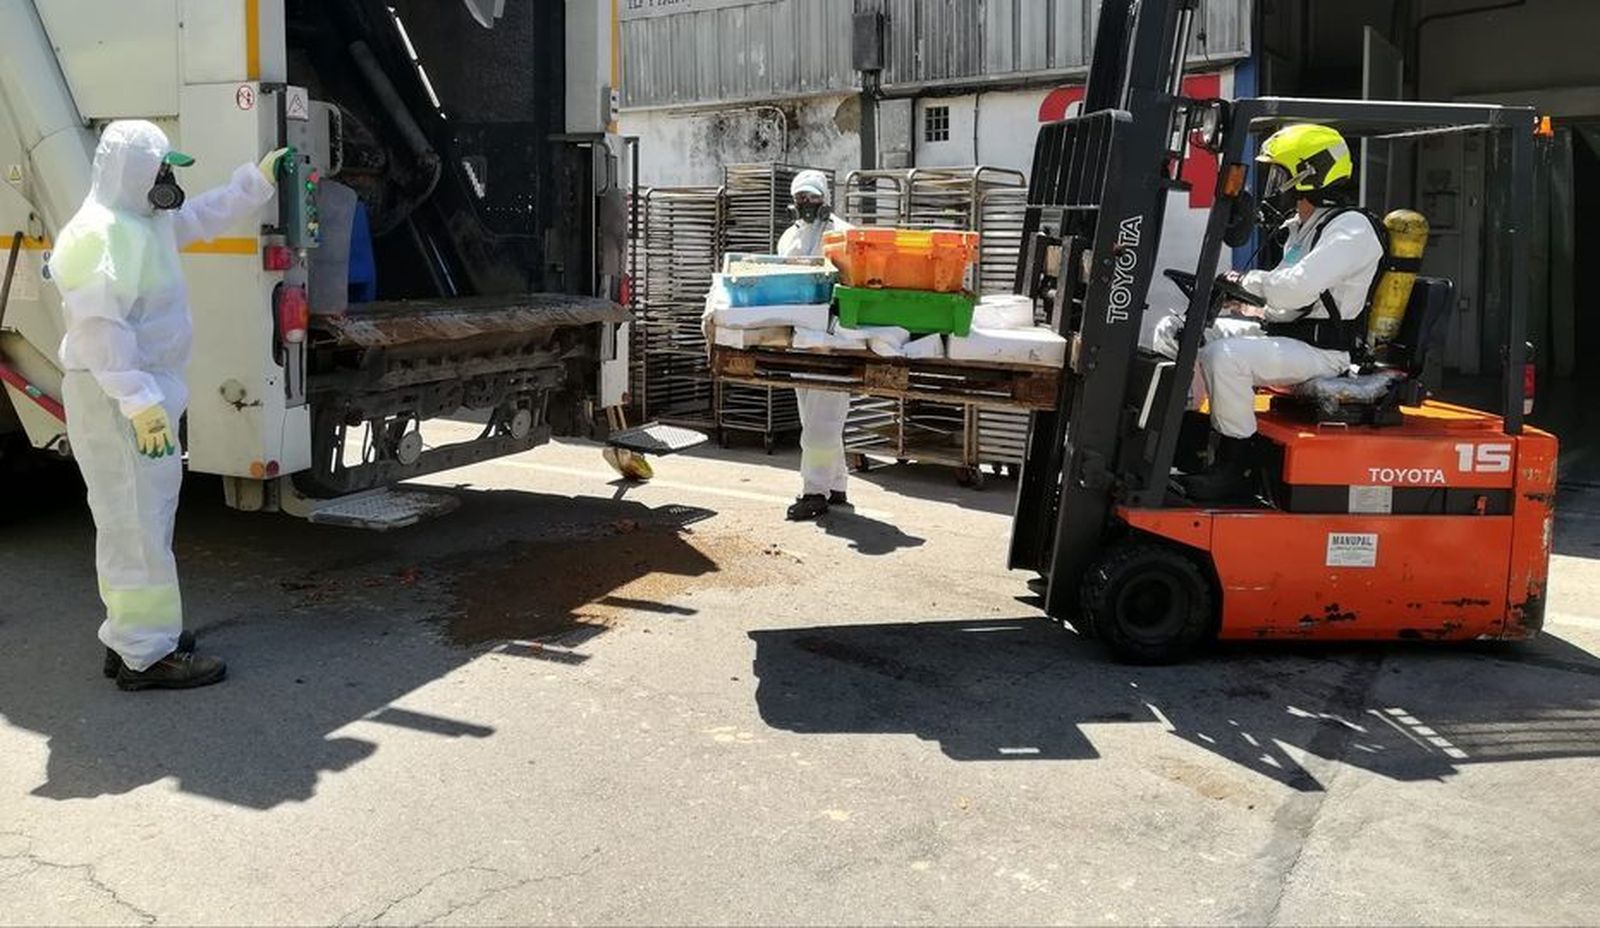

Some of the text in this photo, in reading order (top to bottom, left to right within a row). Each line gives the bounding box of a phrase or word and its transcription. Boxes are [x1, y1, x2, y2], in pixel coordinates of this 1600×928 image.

[1106, 214, 1144, 324] TOYOTA
[1455, 444, 1511, 472] 15
[1369, 468, 1445, 483] TOYOTA
